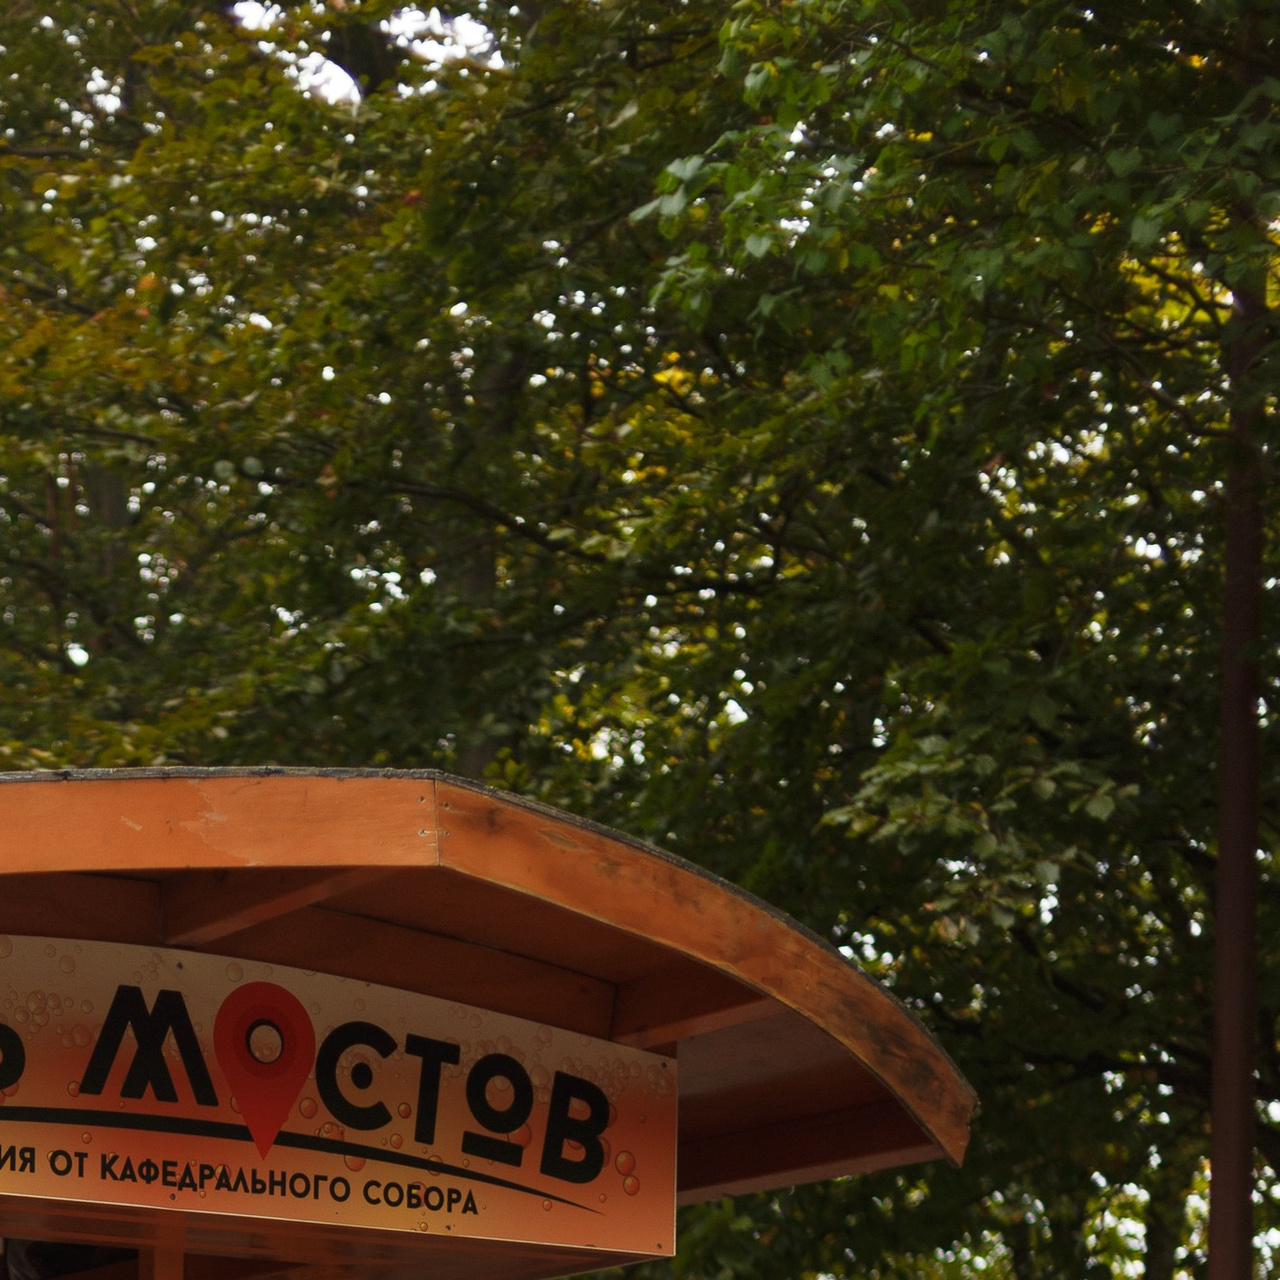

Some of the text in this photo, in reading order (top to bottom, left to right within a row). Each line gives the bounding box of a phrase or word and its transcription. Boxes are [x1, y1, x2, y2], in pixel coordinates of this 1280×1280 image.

[78, 981, 612, 1186] МОСТОВ
[49, 1149, 89, 1178] ОТ
[100, 1153, 352, 1201] КАФЕДРАЛЬНОГО
[362, 1179, 479, 1216] СОБОРА
